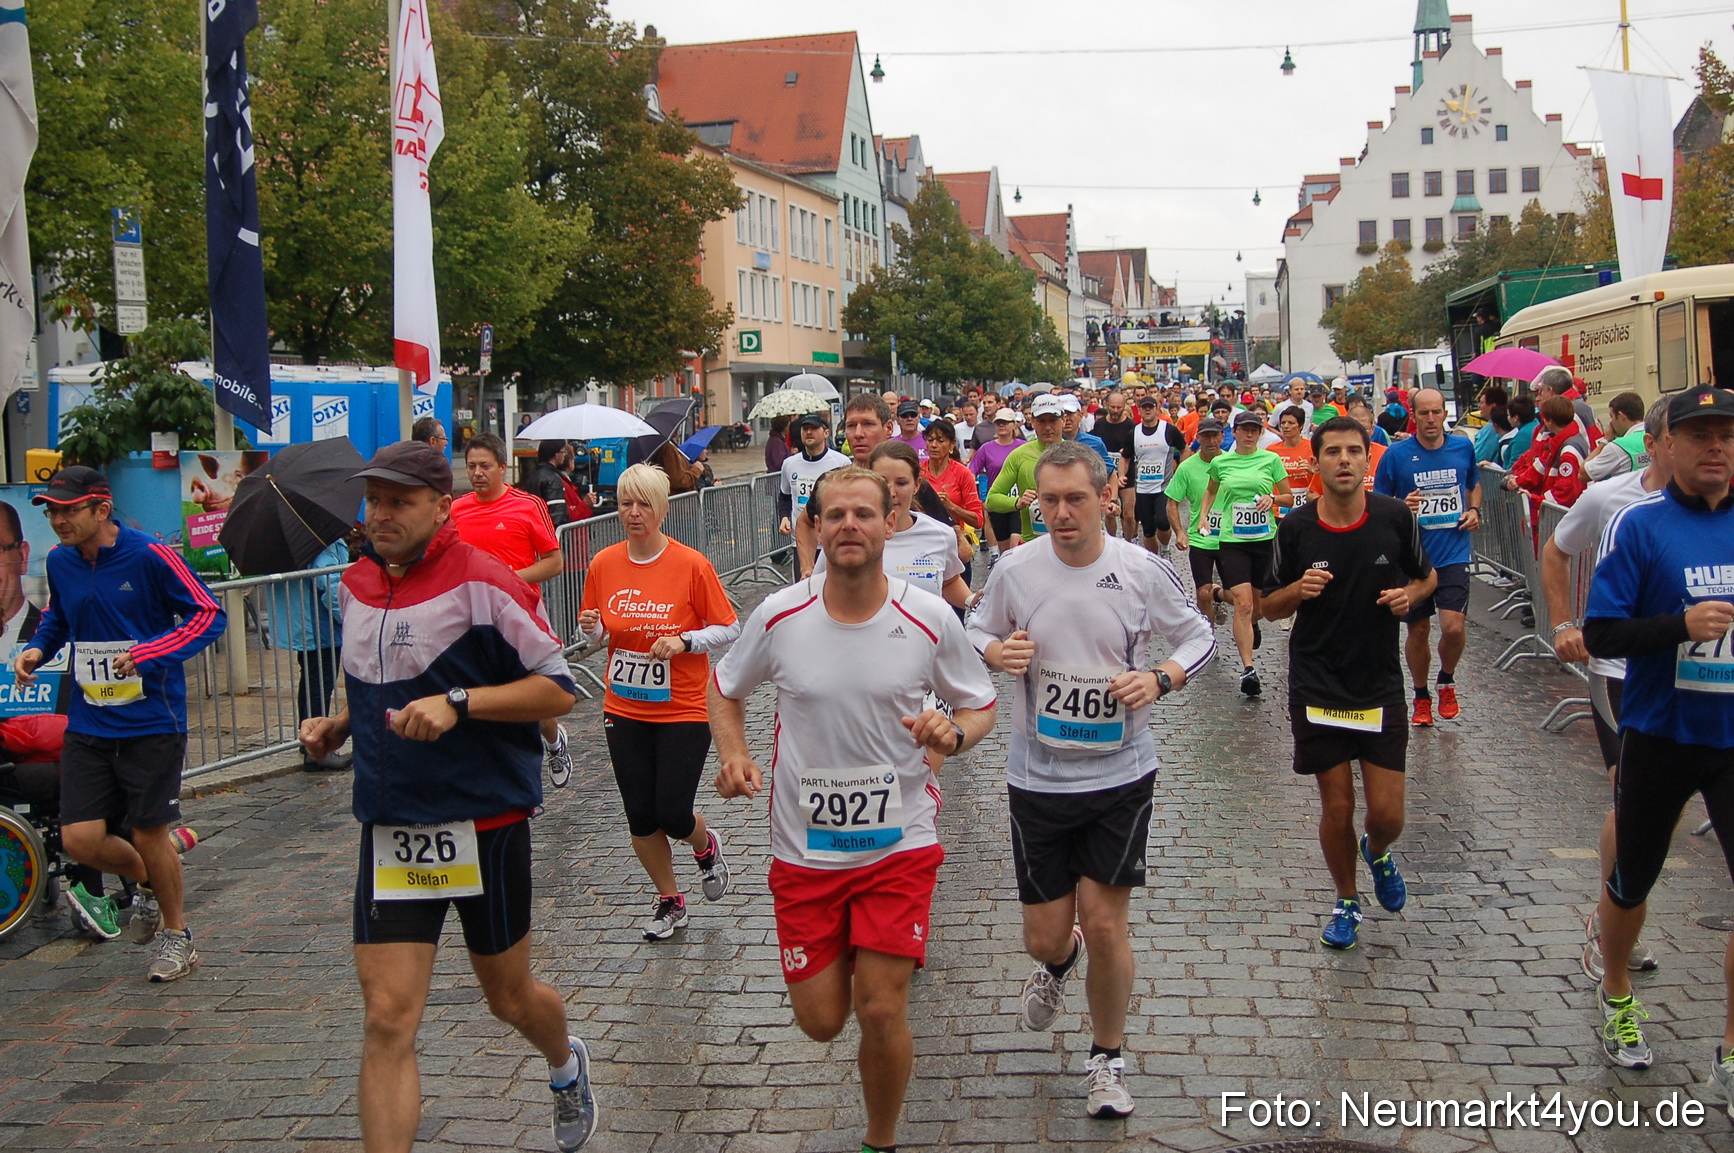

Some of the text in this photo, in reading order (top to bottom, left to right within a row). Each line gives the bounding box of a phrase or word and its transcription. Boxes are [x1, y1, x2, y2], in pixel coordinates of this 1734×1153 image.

[742, 333, 758, 350] D
[1579, 324, 1630, 352] Bayerisches
[1148, 345, 1180, 354] START
[1579, 353, 1603, 373] Rotes
[1582, 378, 1602, 396] reuz
[1141, 465, 1161, 474] 2692
[1413, 468, 1457, 483] HUBER
[1420, 496, 1458, 515] 2768
[1236, 511, 1267, 525] 2906
[192, 524, 214, 536] BEIDE
[1096, 582, 1123, 591] adidas
[617, 599, 674, 613] Fischer
[613, 659, 666, 686] 2779
[1040, 668, 1068, 682] PARTL
[100, 687, 115, 698] HG
[627, 689, 649, 700] Petra
[1044, 683, 1118, 720] 2469
[1322, 707, 1365, 721] Matthias
[1059, 724, 1099, 740] Stefan
[801, 776, 880, 788] PARTL Neumarkt
[808, 788, 891, 827] 2927
[393, 829, 458, 865] 326
[830, 835, 876, 849] Jochen
[407, 870, 449, 886] Stefan
[782, 946, 808, 972] 85
